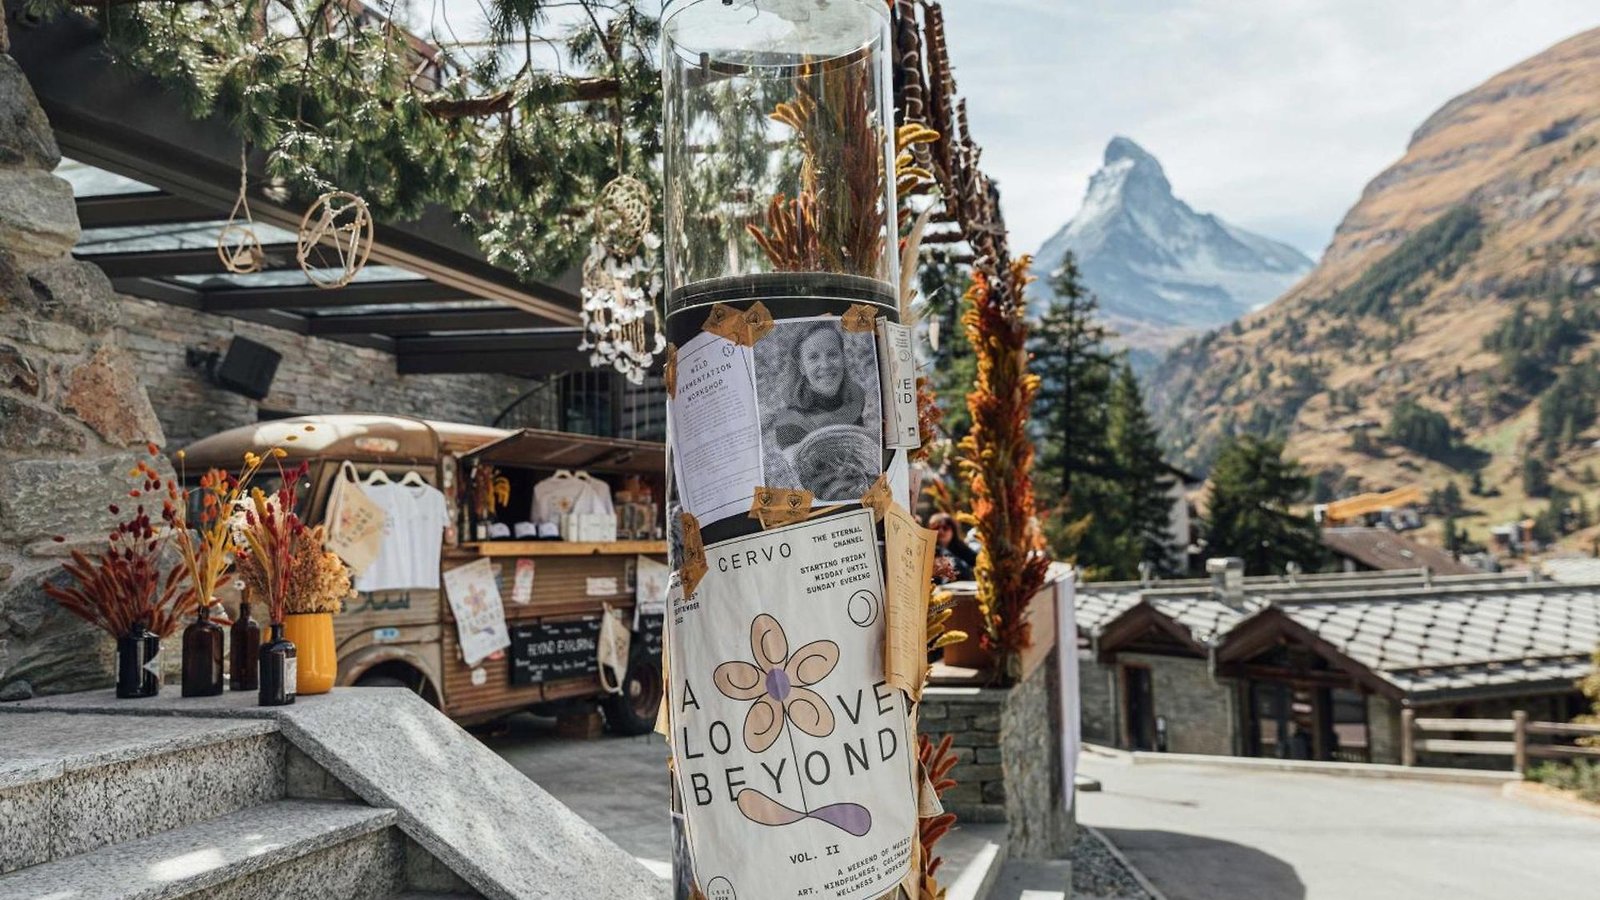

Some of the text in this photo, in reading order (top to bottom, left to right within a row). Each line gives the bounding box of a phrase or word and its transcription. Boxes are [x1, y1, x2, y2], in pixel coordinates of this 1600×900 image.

[687, 379, 724, 402] WORKSHOP
[812, 526, 863, 543] THE ETERNAL
[833, 536, 864, 548] CHANNEL
[718, 542, 792, 572] CERVO
[800, 552, 867, 574] STARTING FRIDAY
[806, 572, 871, 594] SUNDAY EVENING
[815, 563, 869, 581] MIDDAY UNTIL
[682, 679, 700, 712] A
[691, 727, 897, 806] BEYOND
[790, 844, 840, 864] VOL. II
[837, 868, 843, 876] A
[847, 854, 878, 872] WEEKEND
[881, 848, 889, 857] OF
[836, 877, 874, 897] WELLNESS
